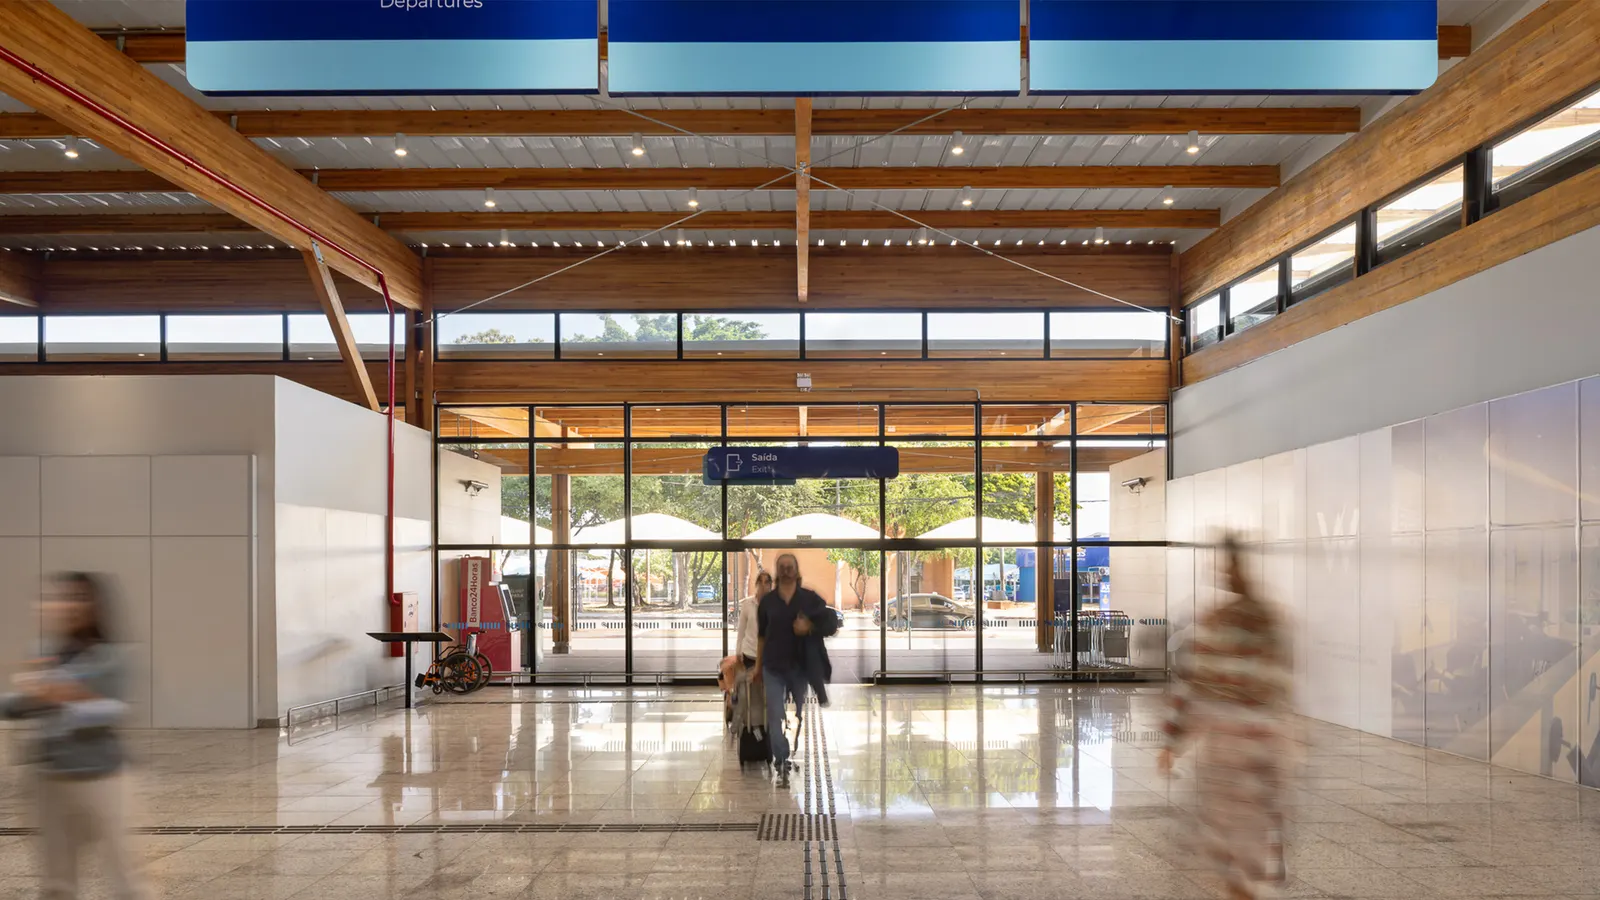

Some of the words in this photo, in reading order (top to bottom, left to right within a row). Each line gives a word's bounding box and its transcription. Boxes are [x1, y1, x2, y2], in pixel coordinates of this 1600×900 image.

[380, 0, 483, 11] Departures
[752, 452, 777, 462] Saída
[752, 465, 768, 473] Exit
[469, 563, 479, 623] Banco24Horas
